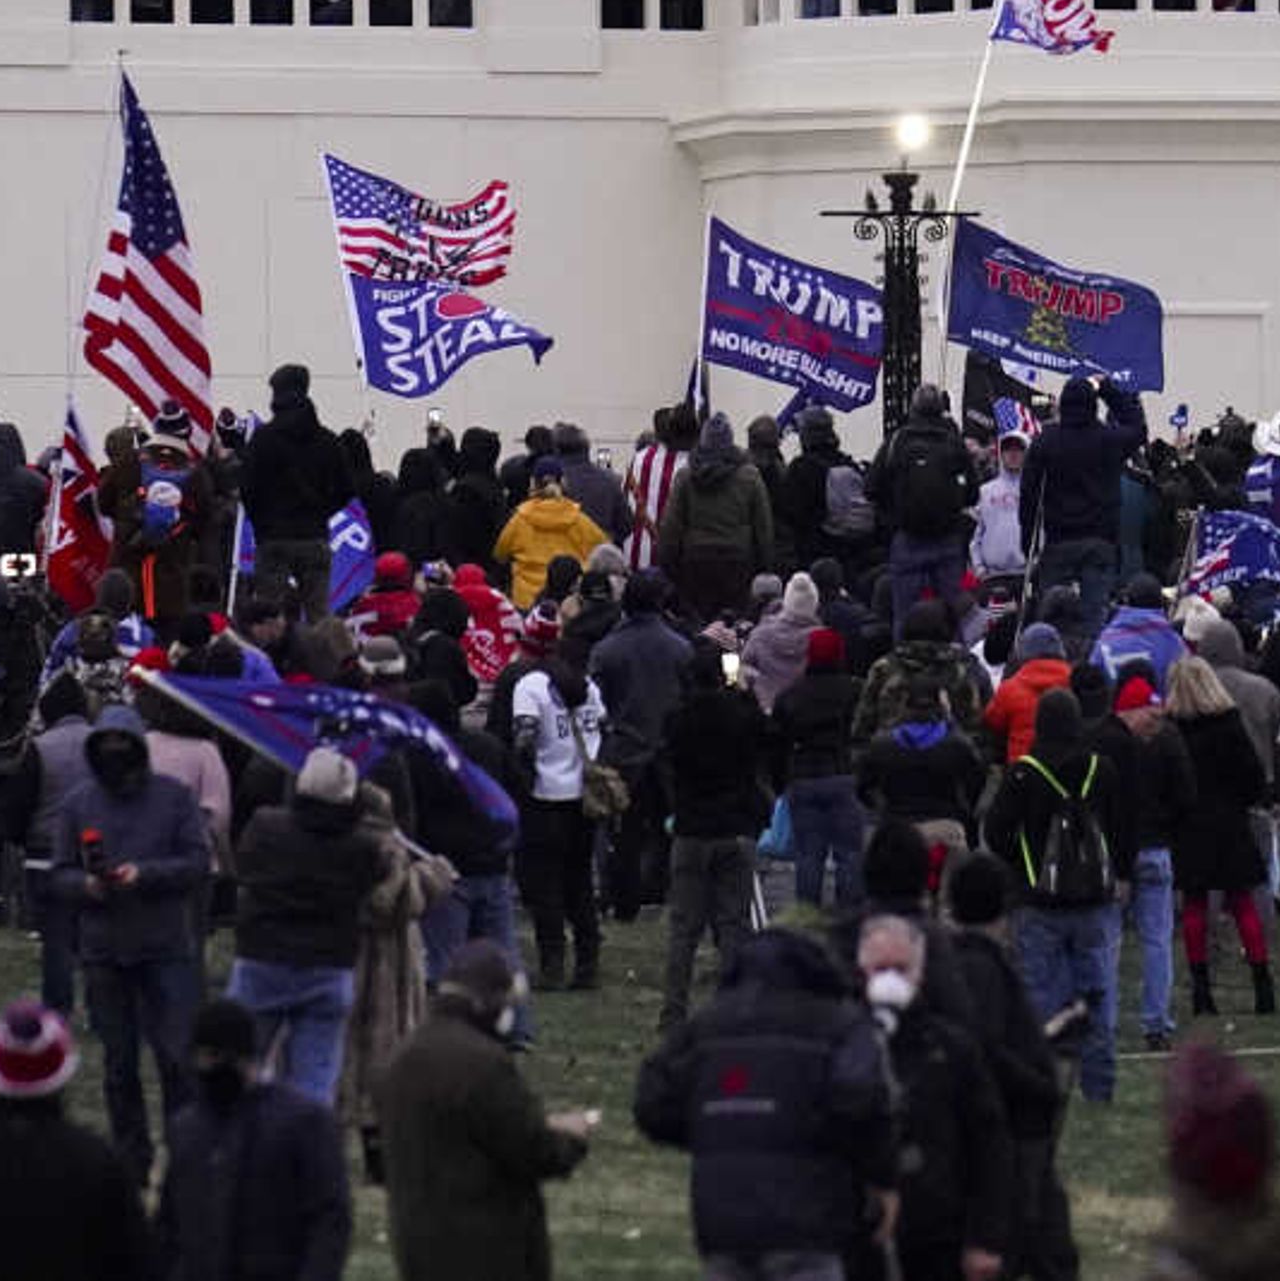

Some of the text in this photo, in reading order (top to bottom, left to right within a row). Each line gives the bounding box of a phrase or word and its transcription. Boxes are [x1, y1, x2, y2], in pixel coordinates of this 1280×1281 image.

[719, 239, 884, 339] TRUMP
[710, 326, 740, 350] NO
[740, 335, 800, 369] MORE
